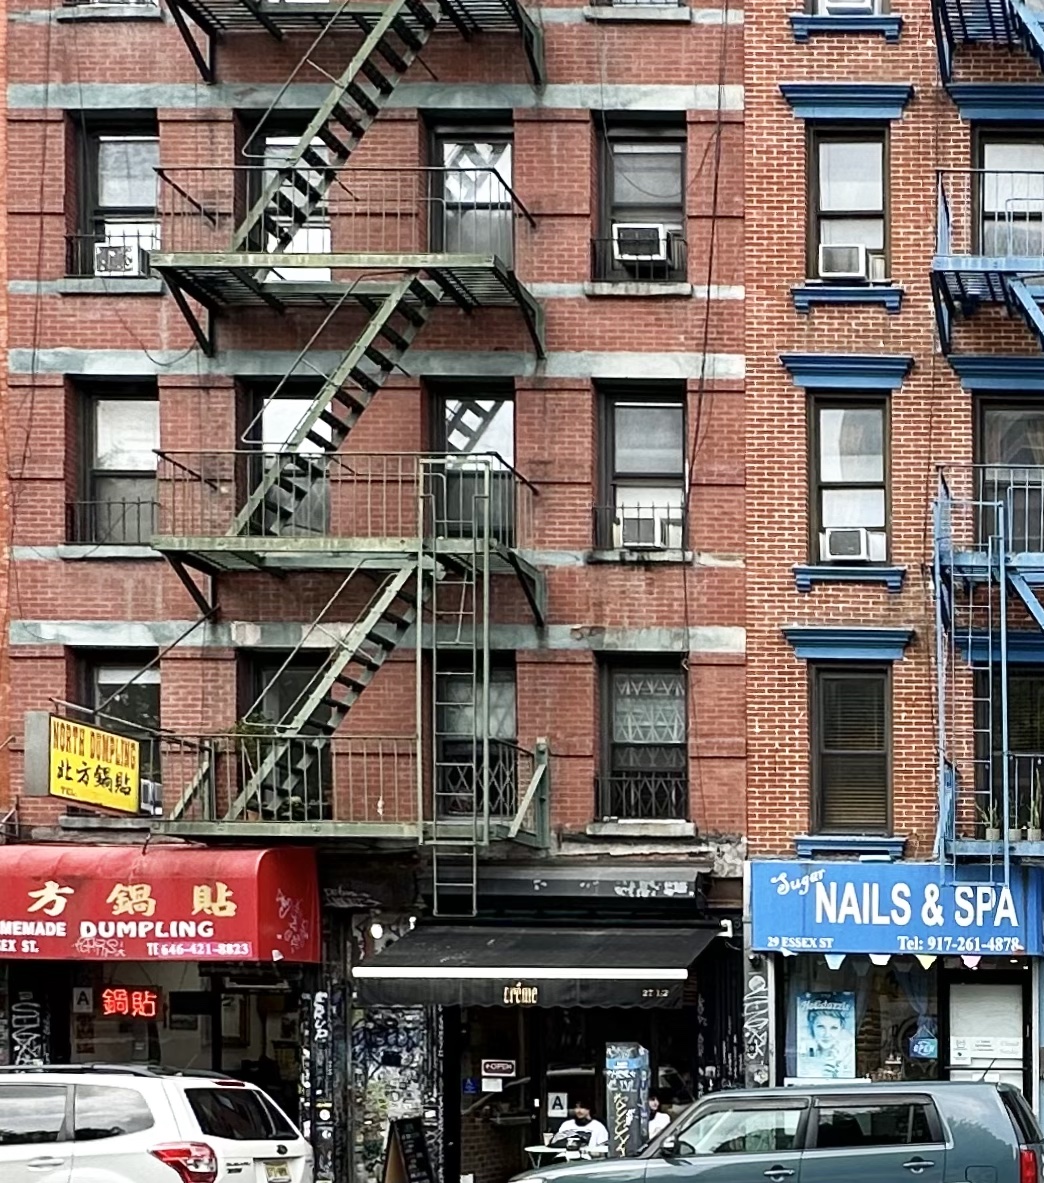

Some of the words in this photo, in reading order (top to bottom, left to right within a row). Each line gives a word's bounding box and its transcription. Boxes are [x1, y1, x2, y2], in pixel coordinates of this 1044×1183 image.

[53, 721, 85, 757] NORTH
[89, 731, 136, 770] DUMPLING
[56, 758, 132, 796] 北方鍋貼
[770, 868, 827, 896] Sugar
[815, 881, 911, 926] NAILS
[921, 882, 944, 926] &
[954, 885, 1020, 927] SPA
[80, 921, 215, 938] DUMPLING
[767, 936, 781, 948] 29
[782, 936, 818, 949] ESSEX
[819, 937, 834, 949] ST
[897, 935, 924, 952] Tel:
[926, 936, 1020, 952] 917-261-4878
[77, 990, 90, 1006] A
[101, 988, 158, 1017] 鍋貼
[551, 1095, 565, 1110] A
